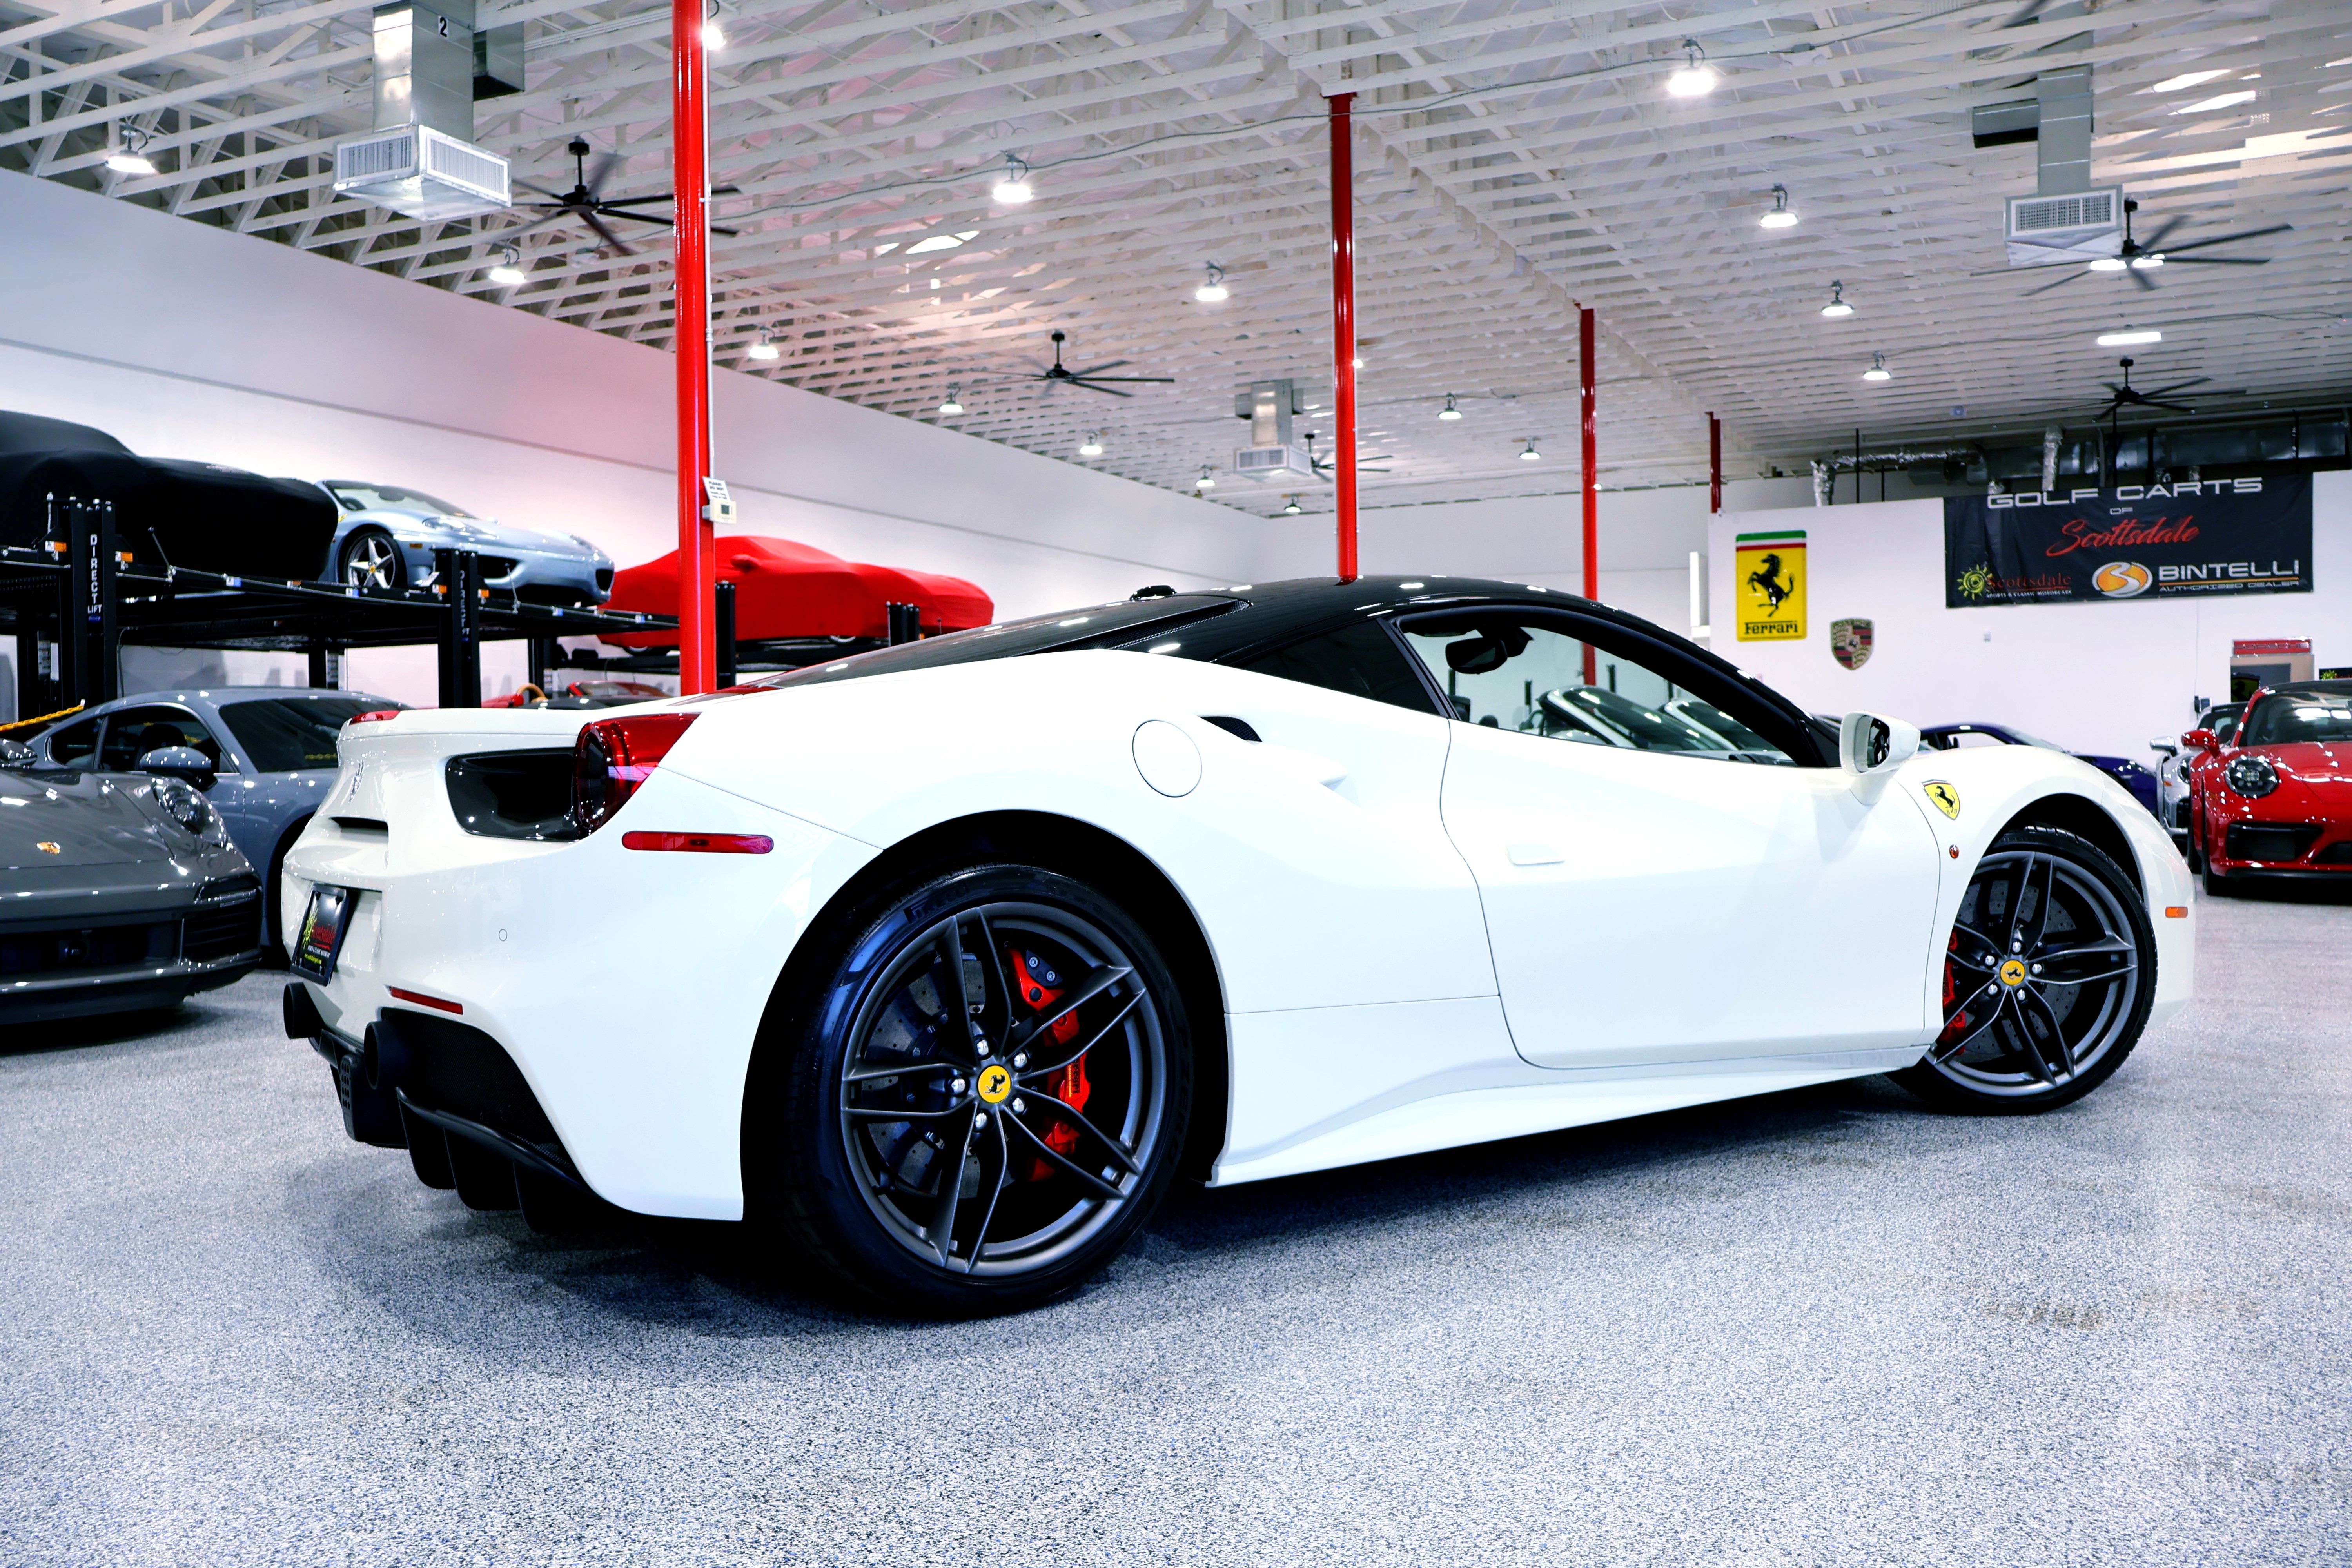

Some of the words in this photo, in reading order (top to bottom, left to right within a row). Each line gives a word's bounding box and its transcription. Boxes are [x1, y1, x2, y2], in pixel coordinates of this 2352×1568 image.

[440, 17, 447, 38] 2
[1987, 488, 2099, 509] GOLF
[2117, 477, 2263, 501] CARTS
[2110, 507, 2133, 515] OF
[2046, 515, 2200, 557] Scottsdale
[90, 534, 98, 604] DIRECT
[2159, 559, 2299, 581] BINTELLI
[1986, 573, 2071, 590] Scottsdale
[87, 604, 102, 614] LIFT
[1744, 620, 1798, 635] Ferrari
